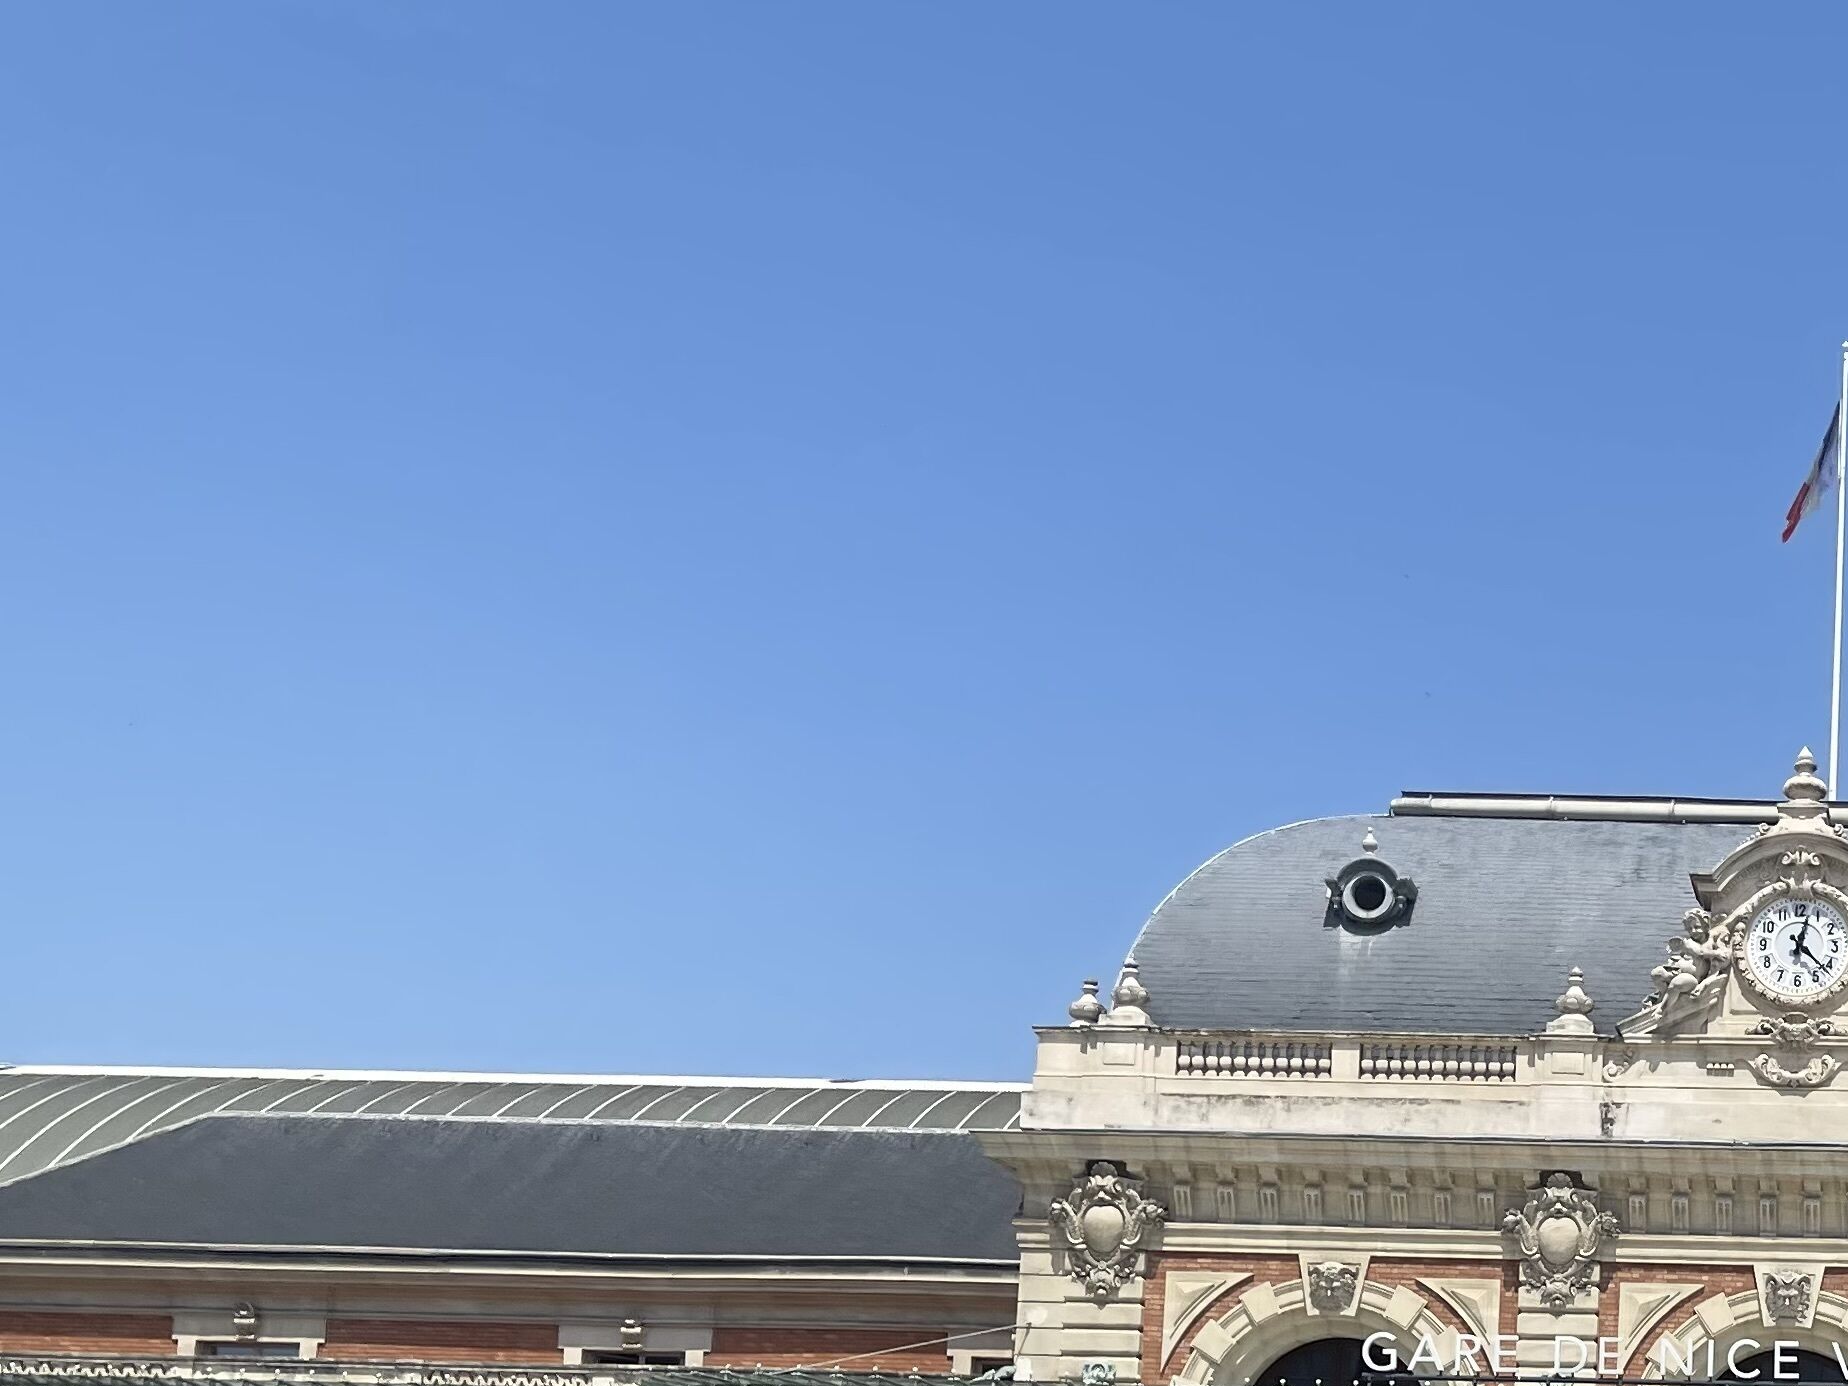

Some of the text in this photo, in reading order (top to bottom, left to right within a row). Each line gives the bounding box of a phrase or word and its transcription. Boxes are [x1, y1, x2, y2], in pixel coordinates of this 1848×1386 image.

[1778, 909, 1787, 921] 11
[1794, 904, 1806, 917] 12
[1816, 910, 1820, 922] 1
[1762, 921, 1774, 933] 10
[1827, 923, 1834, 935] 2
[1760, 938, 1767, 951] 9
[1831, 940, 1838, 953] 3
[1763, 956, 1771, 968] 8
[1826, 957, 1833, 969] 4
[1777, 970, 1784, 982] 7
[1794, 975, 1801, 987] 6
[1812, 970, 1819, 982] 5
[1361, 1331, 1519, 1377] GARE
[1554, 1334, 1623, 1376] DE
[1658, 1338, 1800, 1379] NICE
